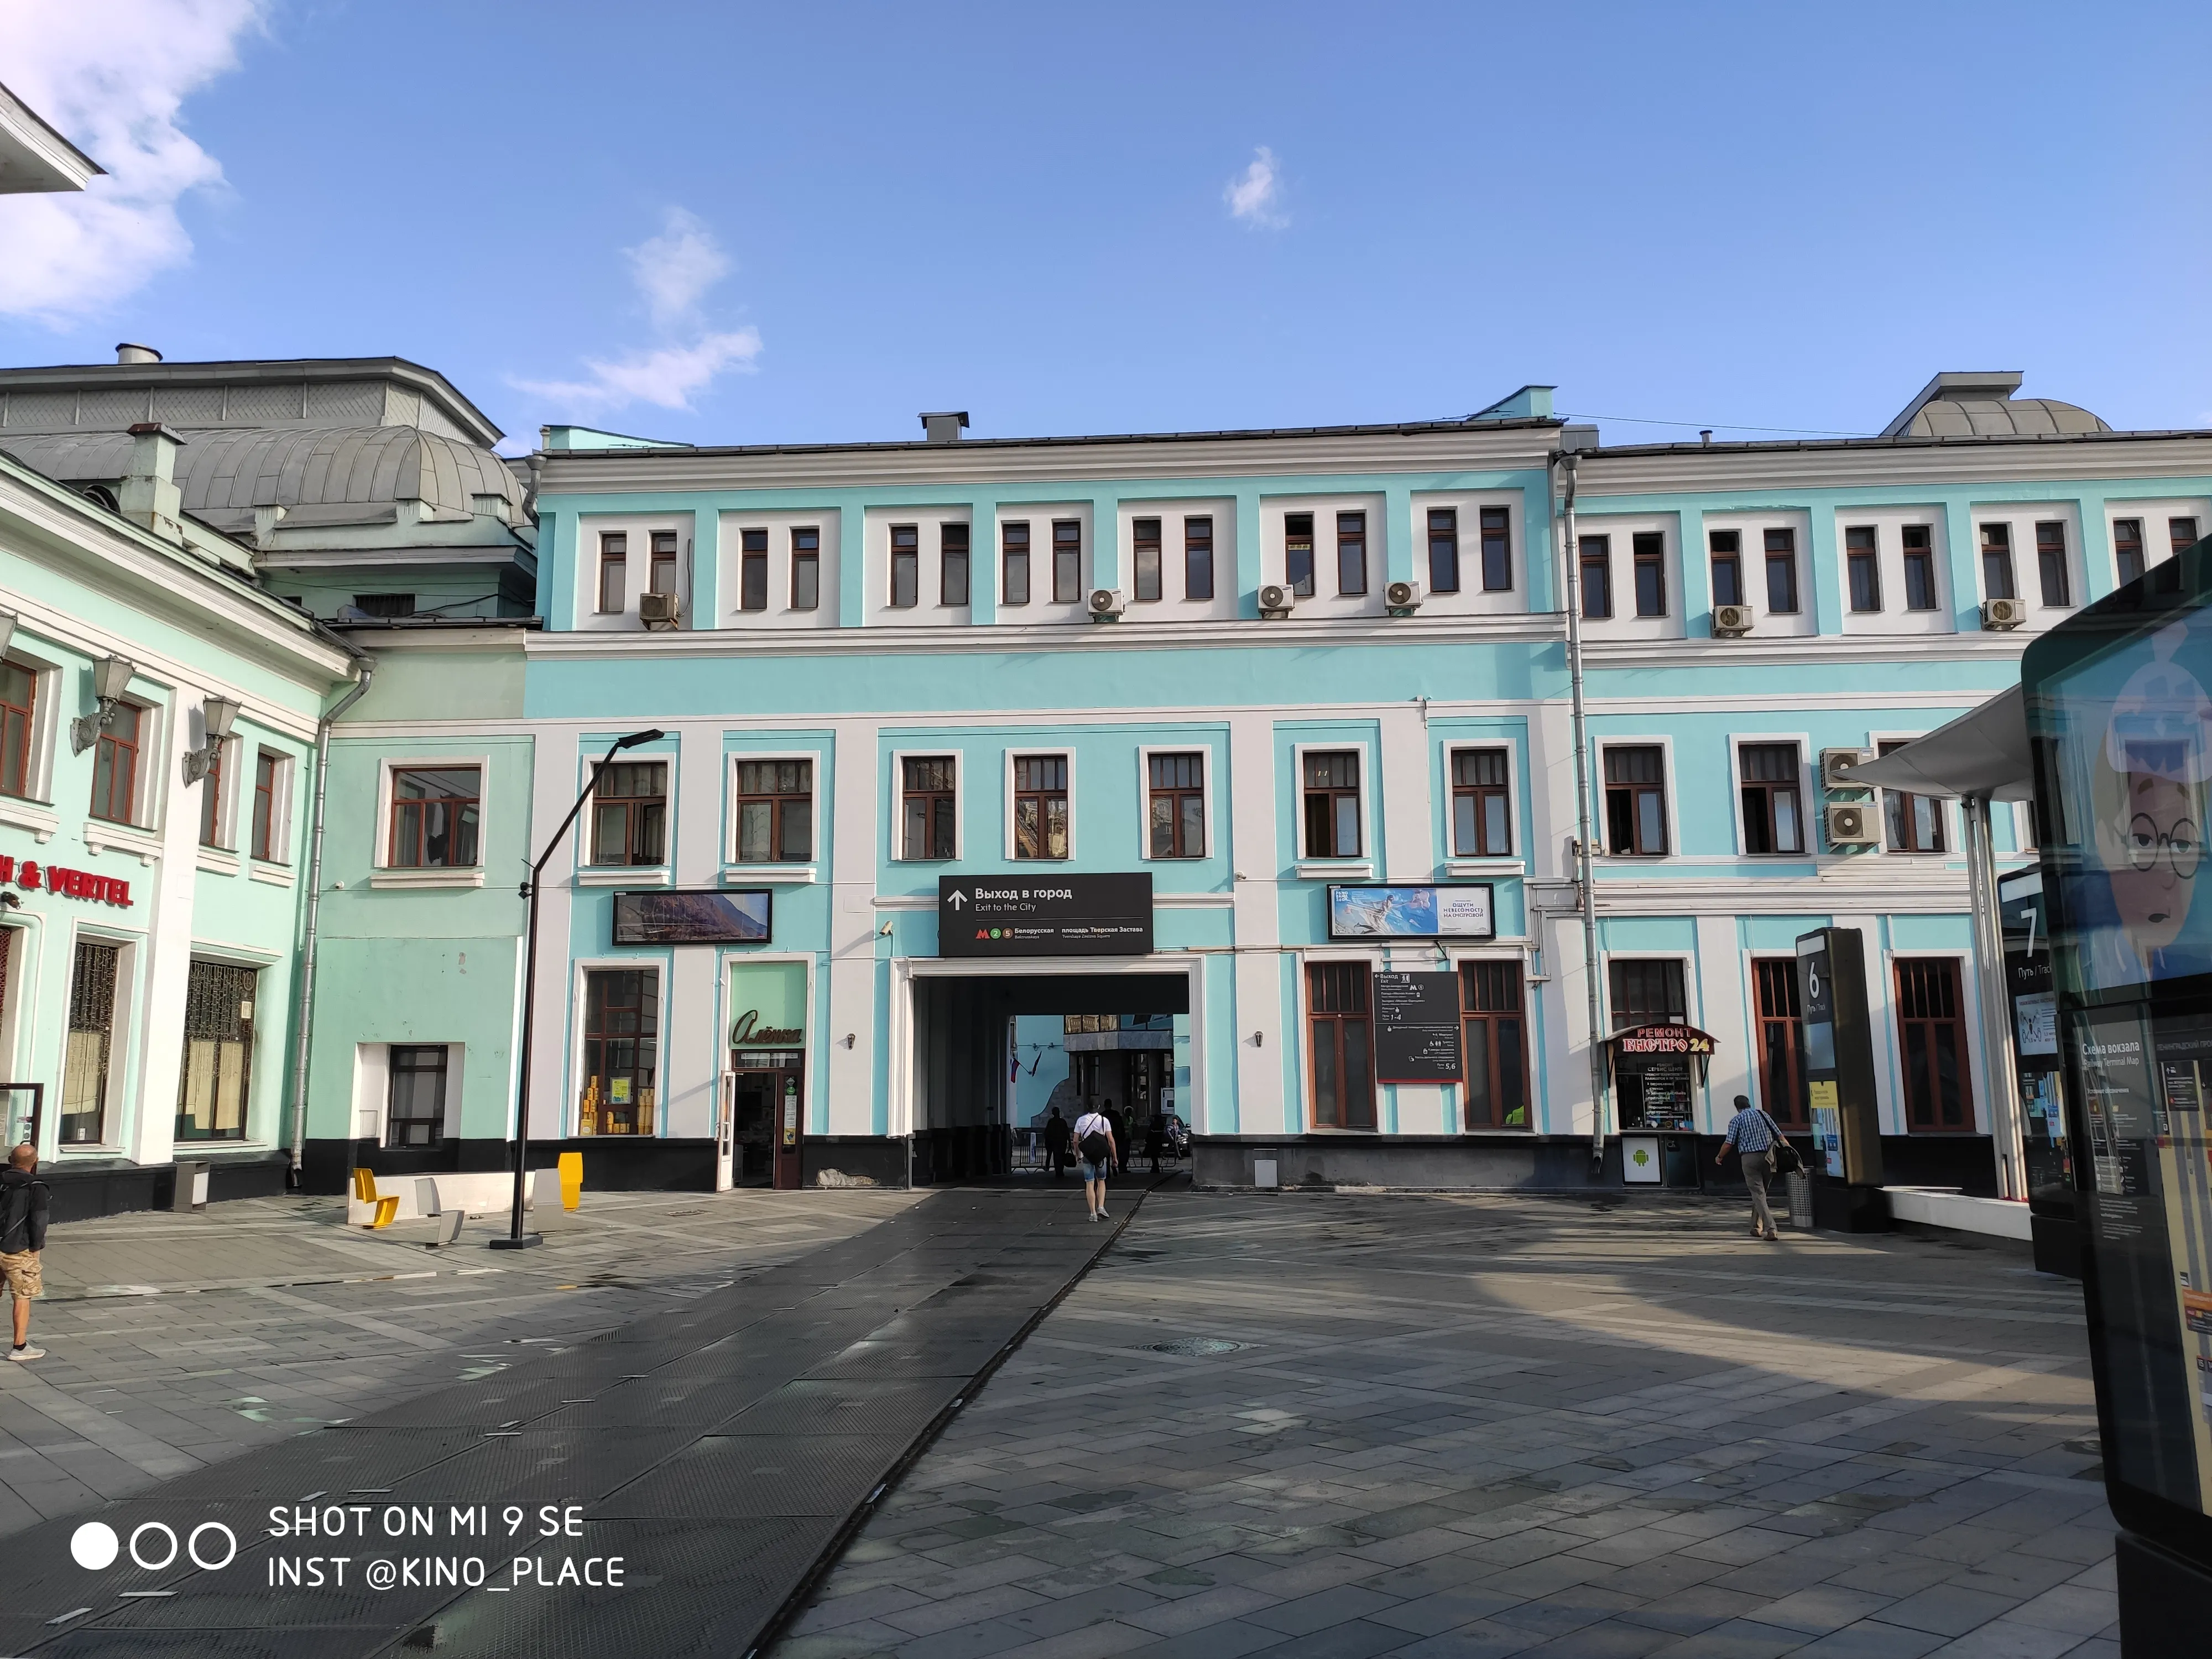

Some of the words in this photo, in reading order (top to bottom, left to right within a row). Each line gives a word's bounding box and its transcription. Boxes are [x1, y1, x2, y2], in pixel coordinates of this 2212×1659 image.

[45, 865, 134, 907] VERTEL
[975, 888, 1019, 900] Выход
[1022, 890, 1030, 898] в
[1034, 889, 1072, 900] город
[975, 903, 991, 911] Exit
[993, 903, 1001, 911] to
[1004, 902, 1017, 911] the
[1019, 902, 1036, 912] City
[2021, 907, 2037, 958] 7
[1809, 962, 1819, 998] 6
[2018, 967, 2033, 980] Путь
[732, 1009, 802, 1044] Алёнка
[1637, 1027, 1692, 1037] РЕМОНТ
[1623, 1039, 1688, 1052] БЫСТРО
[1689, 1038, 1710, 1052] 24
[2082, 1043, 2106, 1055] Схема
[2107, 1041, 2140, 1053] вокзала
[2084, 1059, 2103, 1068] Railway
[2103, 1057, 2125, 1067] Terminal
[2126, 1056, 2139, 1066] Map
